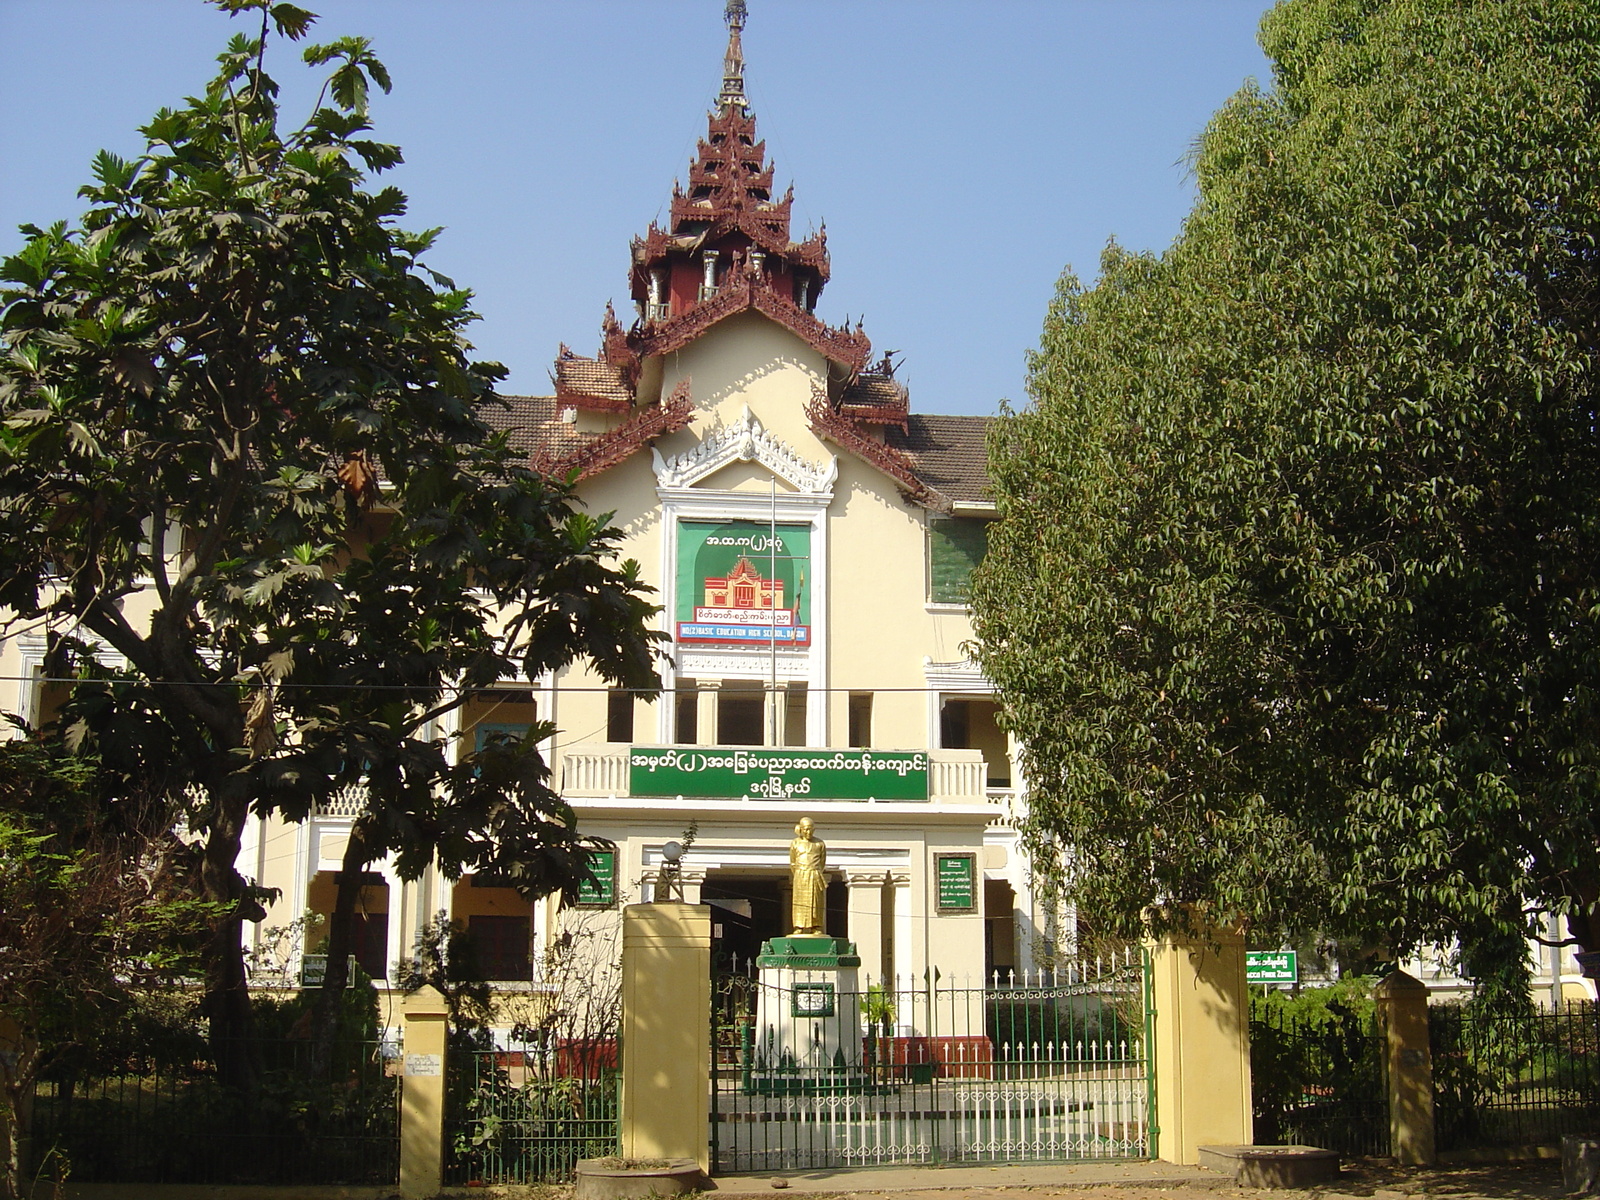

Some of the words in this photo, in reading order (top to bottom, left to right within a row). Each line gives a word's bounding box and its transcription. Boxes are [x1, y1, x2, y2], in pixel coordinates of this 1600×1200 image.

[716, 627, 746, 637] EDUCATION
[748, 629, 761, 637] HIGH
[750, 776, 811, 798] ဒဂုံမြို့နယ်
